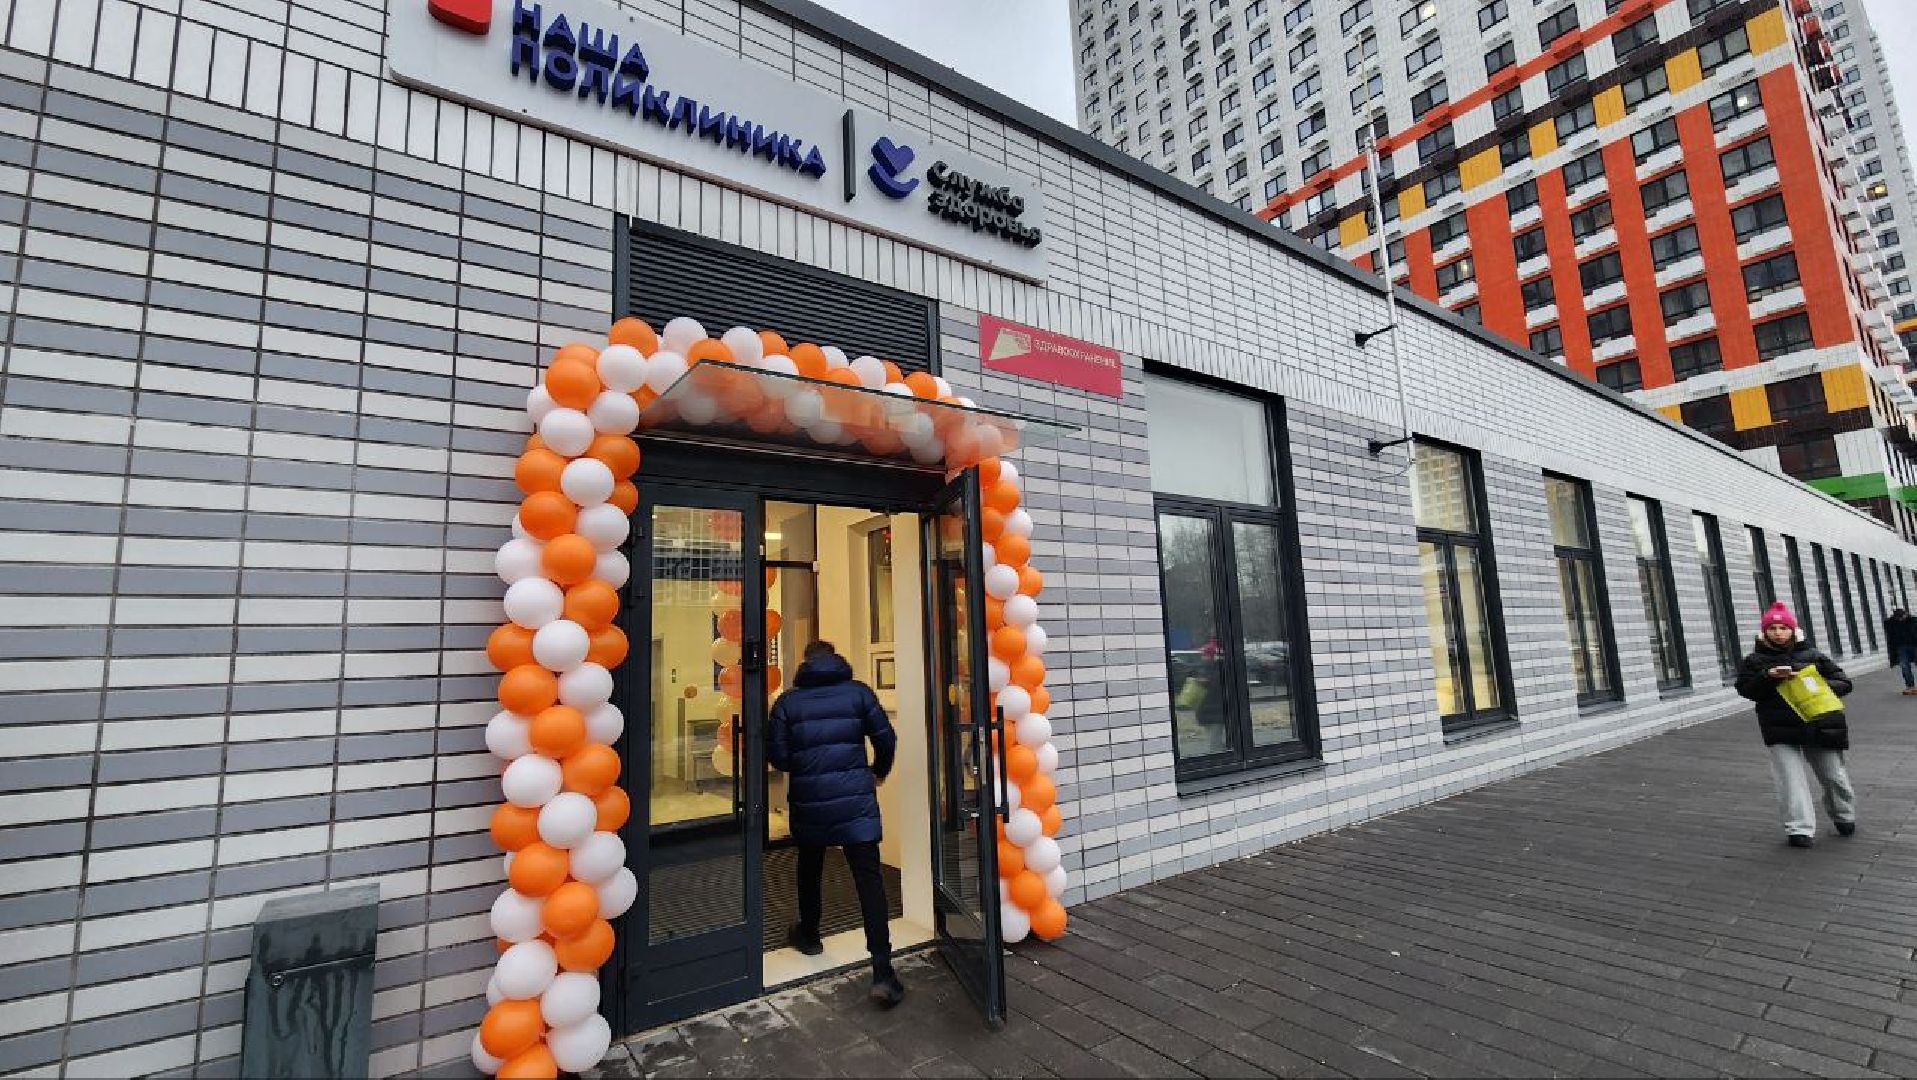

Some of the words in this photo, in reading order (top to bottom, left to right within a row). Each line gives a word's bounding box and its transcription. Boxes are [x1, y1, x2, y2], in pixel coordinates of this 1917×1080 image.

[511, 0, 649, 82] НАША
[510, 36, 827, 178] ПОЛИКЛИНИКА
[926, 161, 1025, 216] Служба
[1033, 339, 1119, 369] ЗДРАВООХРАНЕНИ
